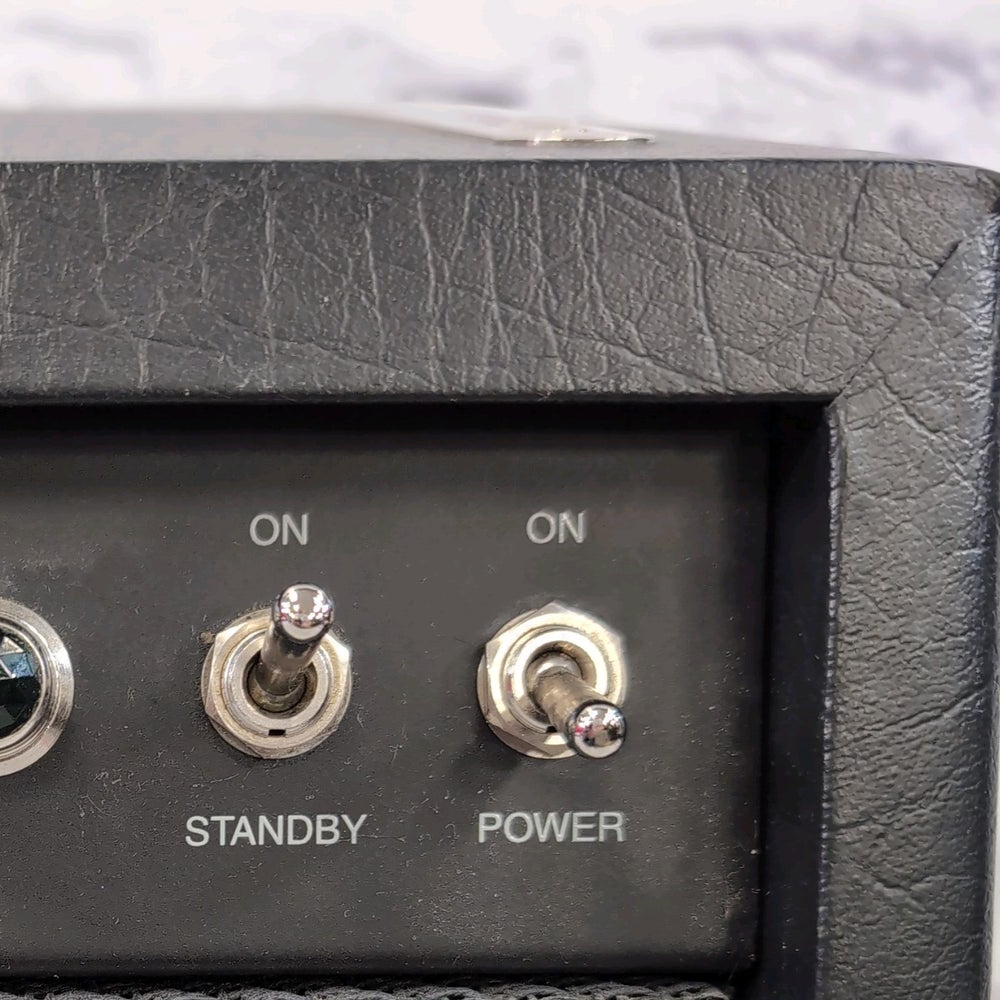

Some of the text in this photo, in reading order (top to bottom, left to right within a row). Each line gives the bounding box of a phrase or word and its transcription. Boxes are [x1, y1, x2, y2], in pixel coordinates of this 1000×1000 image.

[249, 512, 310, 546] ON
[526, 509, 588, 544] ON
[184, 814, 367, 847] STANDBY
[477, 811, 627, 844] POWER
